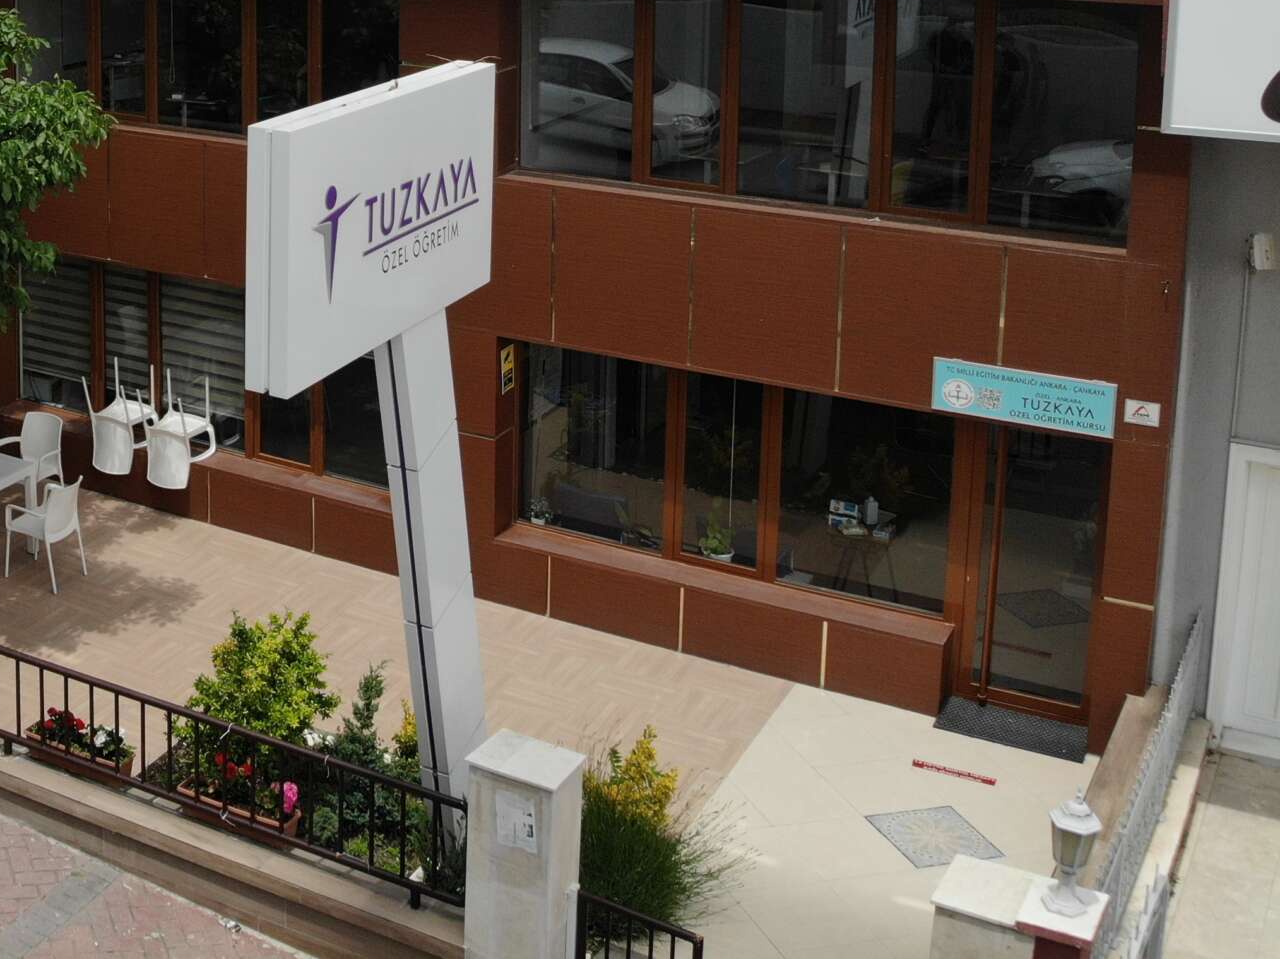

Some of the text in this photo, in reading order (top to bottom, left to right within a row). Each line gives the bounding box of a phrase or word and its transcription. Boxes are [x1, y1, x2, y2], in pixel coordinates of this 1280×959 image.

[364, 156, 478, 244] TUZKAYA
[381, 220, 460, 274] ÖZEL ÖĞRETİM
[1039, 380, 1068, 392] ANKARA
[1009, 408, 1106, 433] ÖZEL ÖĞRETİM KURSU
[1021, 396, 1095, 420] TUZKAYA
